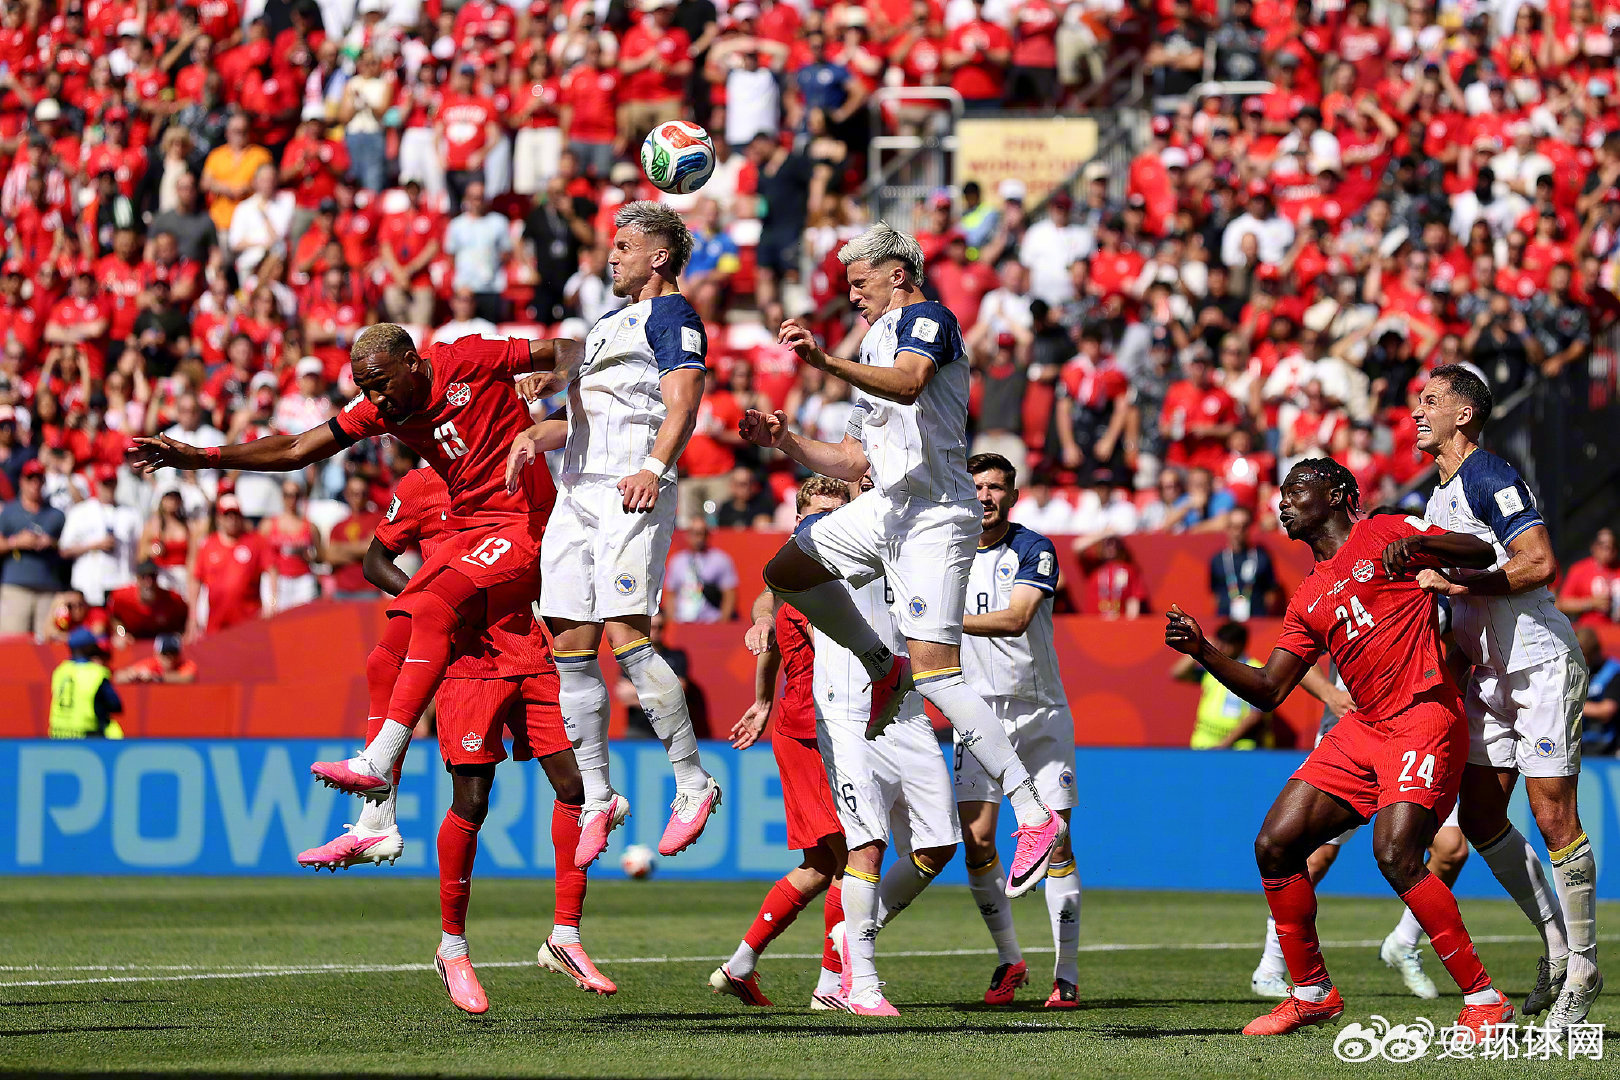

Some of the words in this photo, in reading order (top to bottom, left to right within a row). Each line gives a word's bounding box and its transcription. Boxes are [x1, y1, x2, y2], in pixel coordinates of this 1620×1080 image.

[434, 420, 470, 460] 13
[470, 536, 512, 566] 13
[1334, 594, 1376, 641] 24
[1397, 750, 1436, 789] 24
[841, 782, 858, 813] 6
